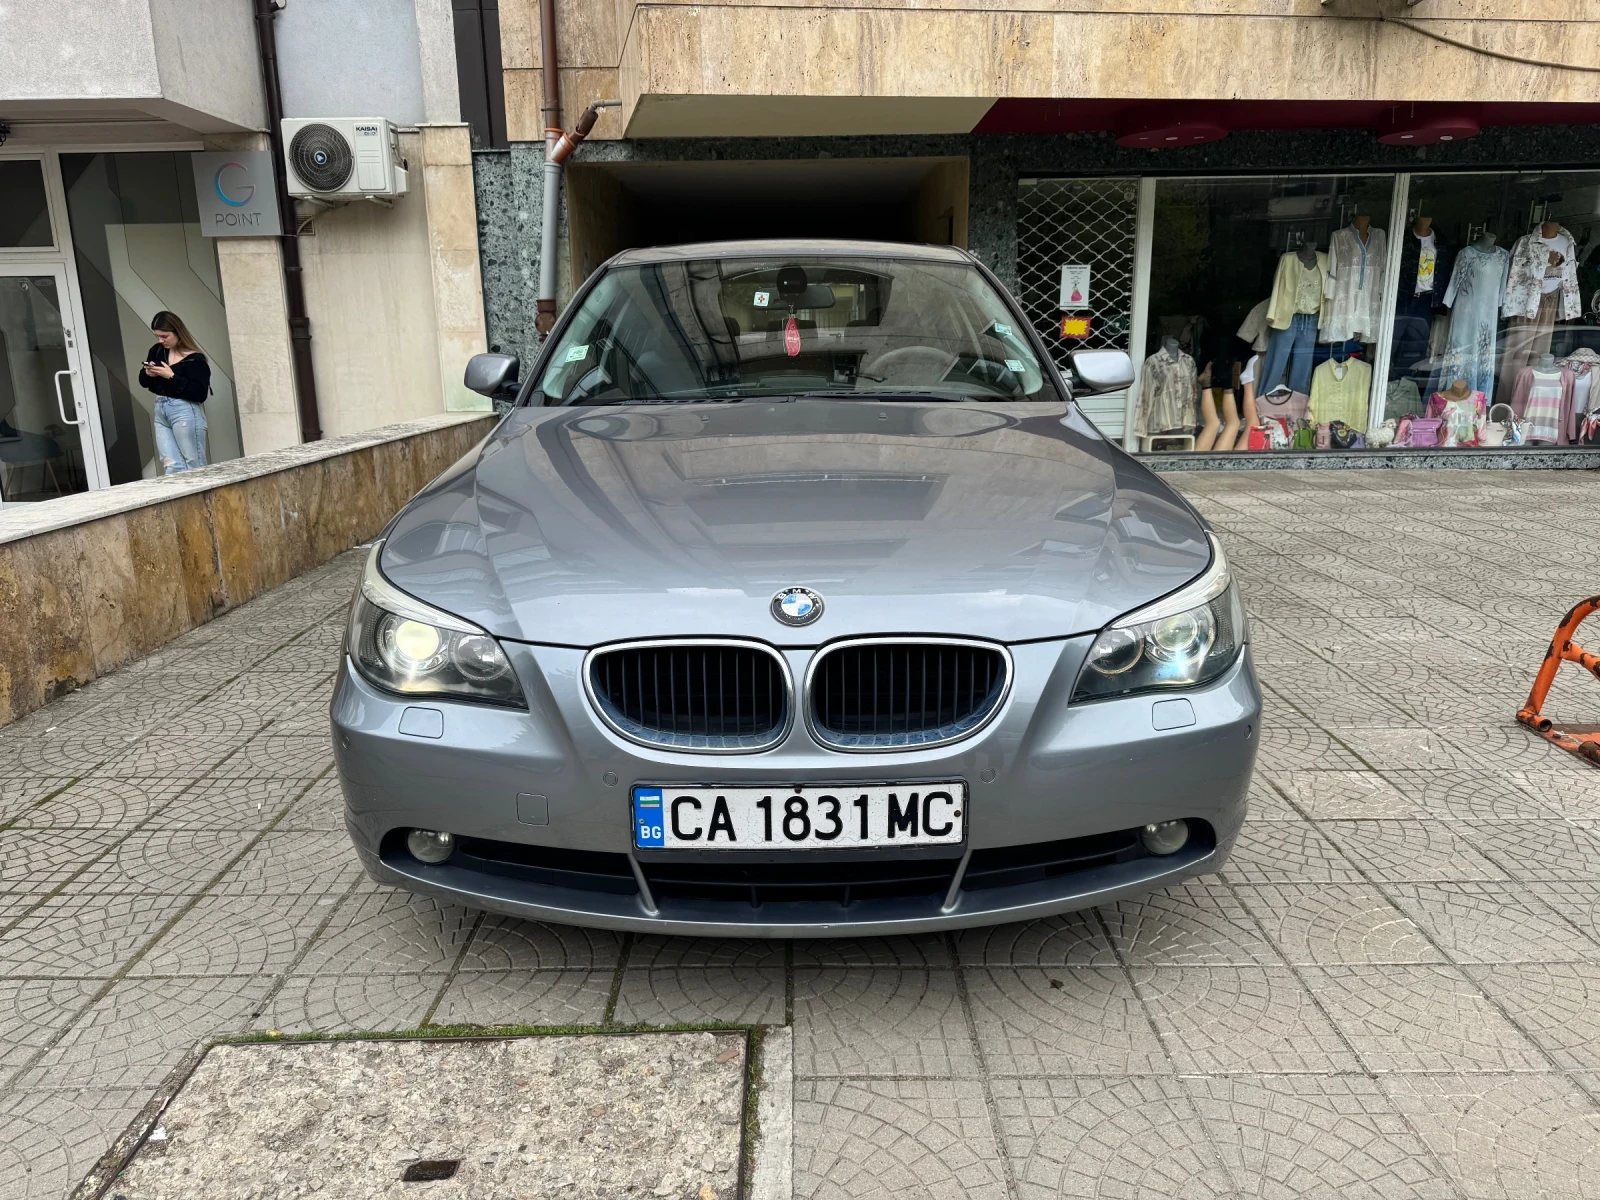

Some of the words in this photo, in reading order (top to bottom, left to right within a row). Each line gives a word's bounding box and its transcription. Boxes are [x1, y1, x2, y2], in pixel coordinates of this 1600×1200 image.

[214, 161, 256, 208] G
[215, 212, 262, 226] POINT
[671, 796, 737, 841] CA
[756, 794, 869, 841] 1831
[887, 791, 954, 839] MC
[641, 826, 662, 839] BG
